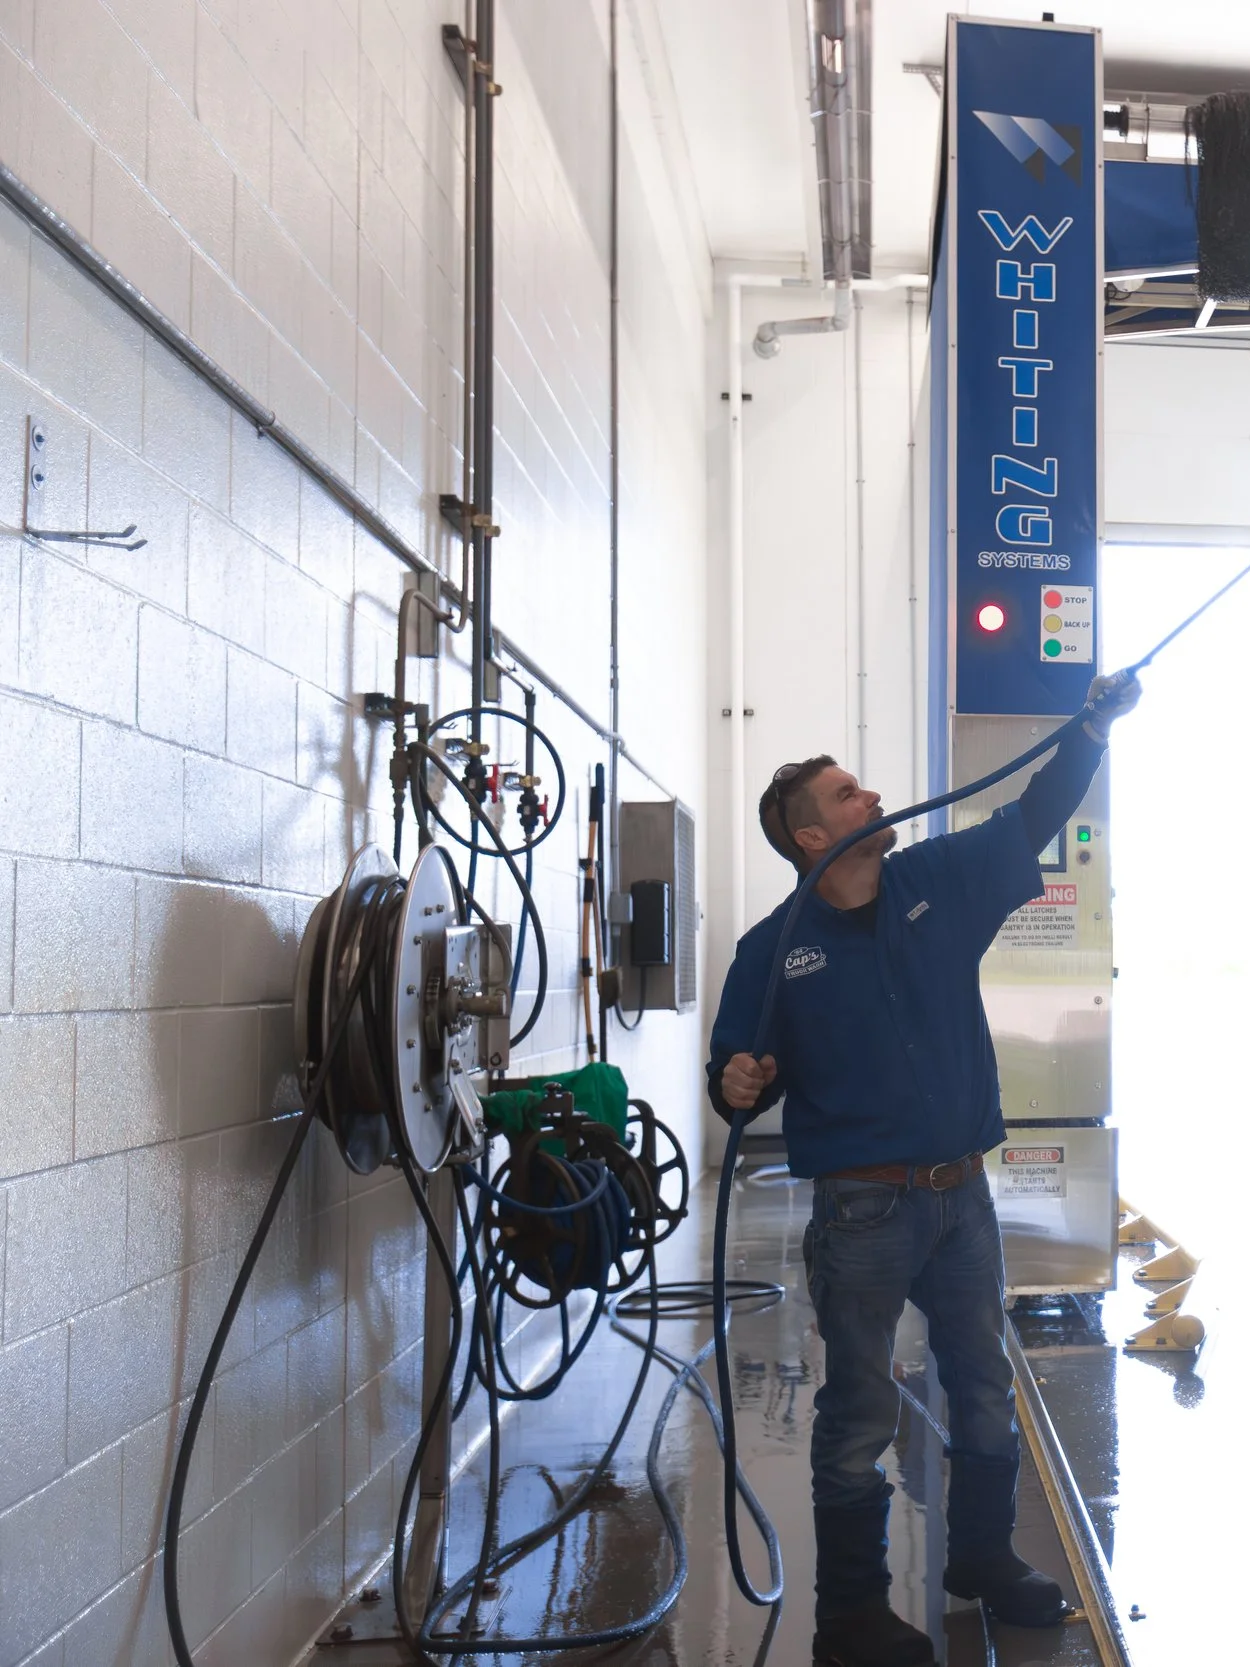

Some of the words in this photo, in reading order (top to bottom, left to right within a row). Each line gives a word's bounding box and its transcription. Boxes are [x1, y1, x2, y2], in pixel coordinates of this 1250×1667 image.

[977, 209, 1074, 546] WHITING
[977, 551, 1071, 571] SYSTEMS
[1064, 596, 1087, 604] STOP
[1041, 923, 1075, 931] OPERATION
[785, 951, 820, 970] Cap's
[1013, 1151, 1053, 1160] DANGER
